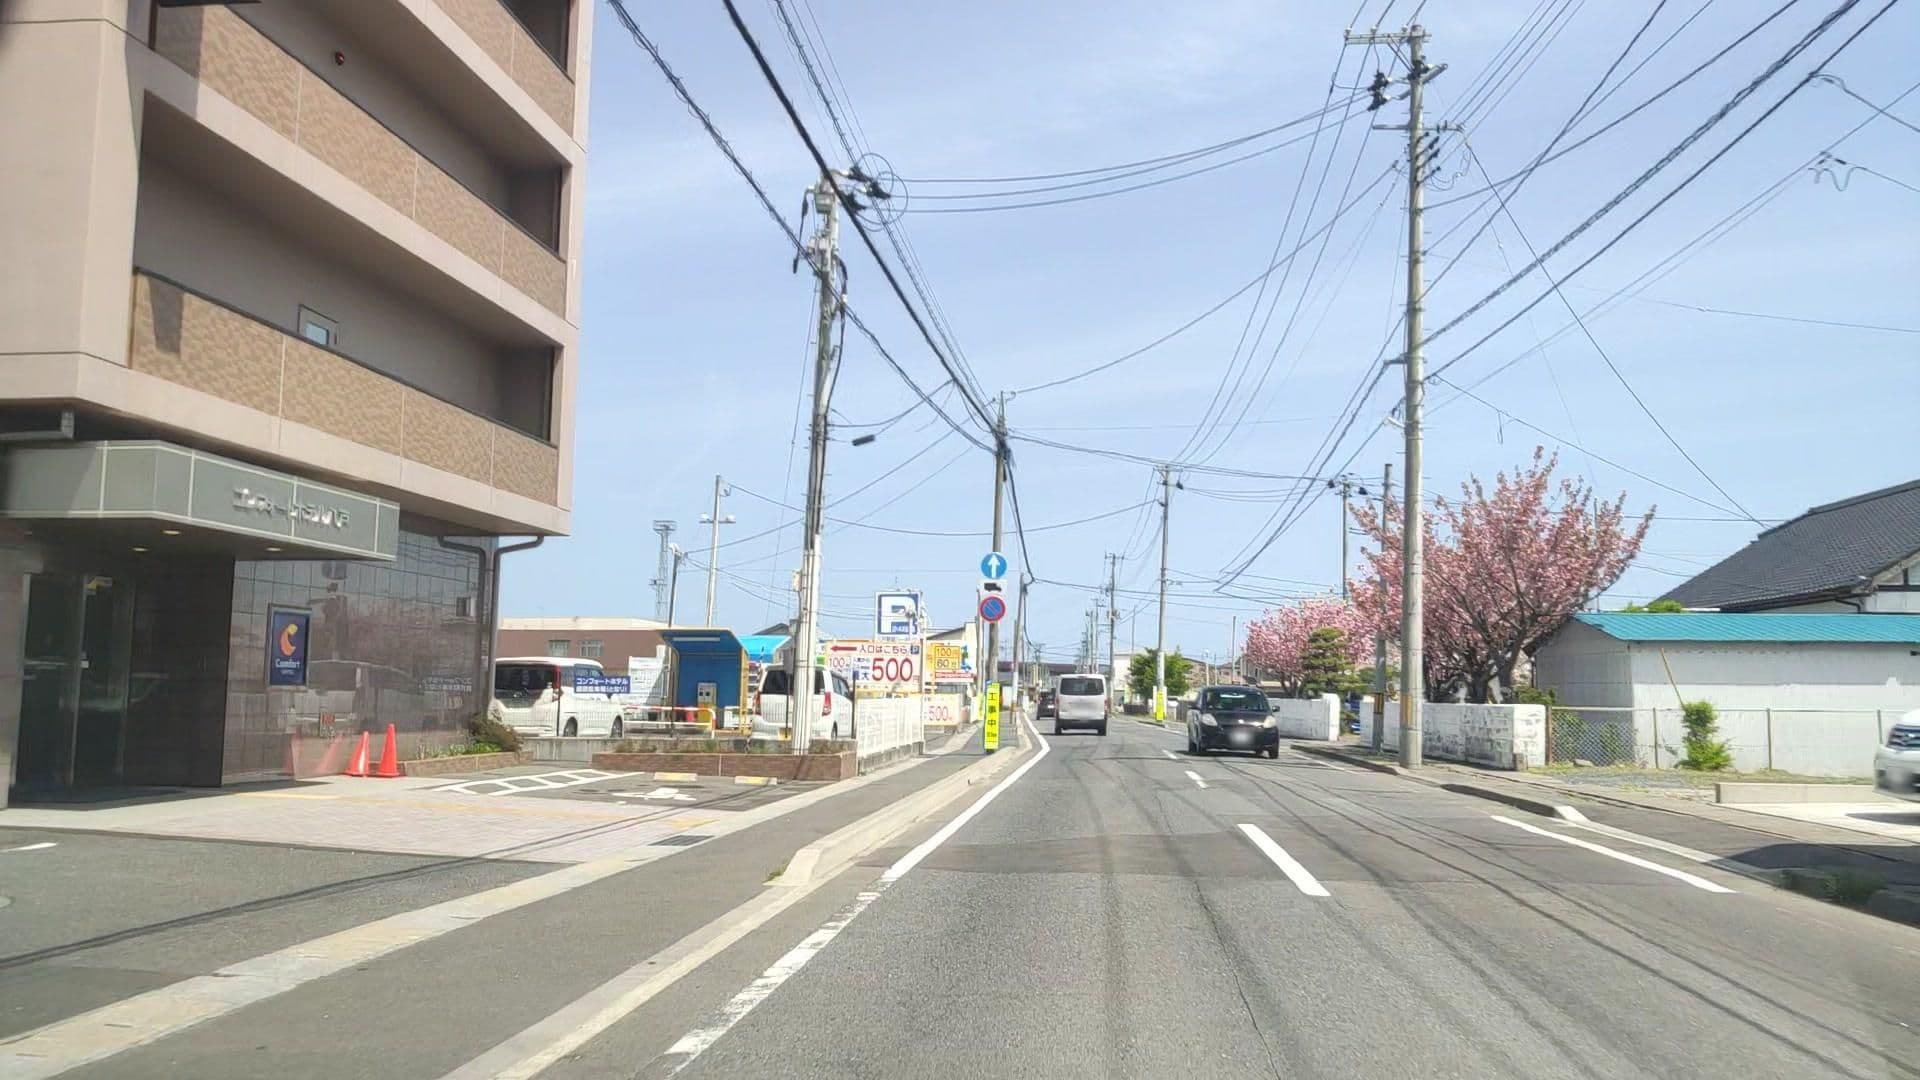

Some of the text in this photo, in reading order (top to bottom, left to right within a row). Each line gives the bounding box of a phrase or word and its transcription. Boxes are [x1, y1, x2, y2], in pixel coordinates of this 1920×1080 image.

[860, 644, 908, 654] 入口はこちら
[987, 692, 998, 728] 工事中
